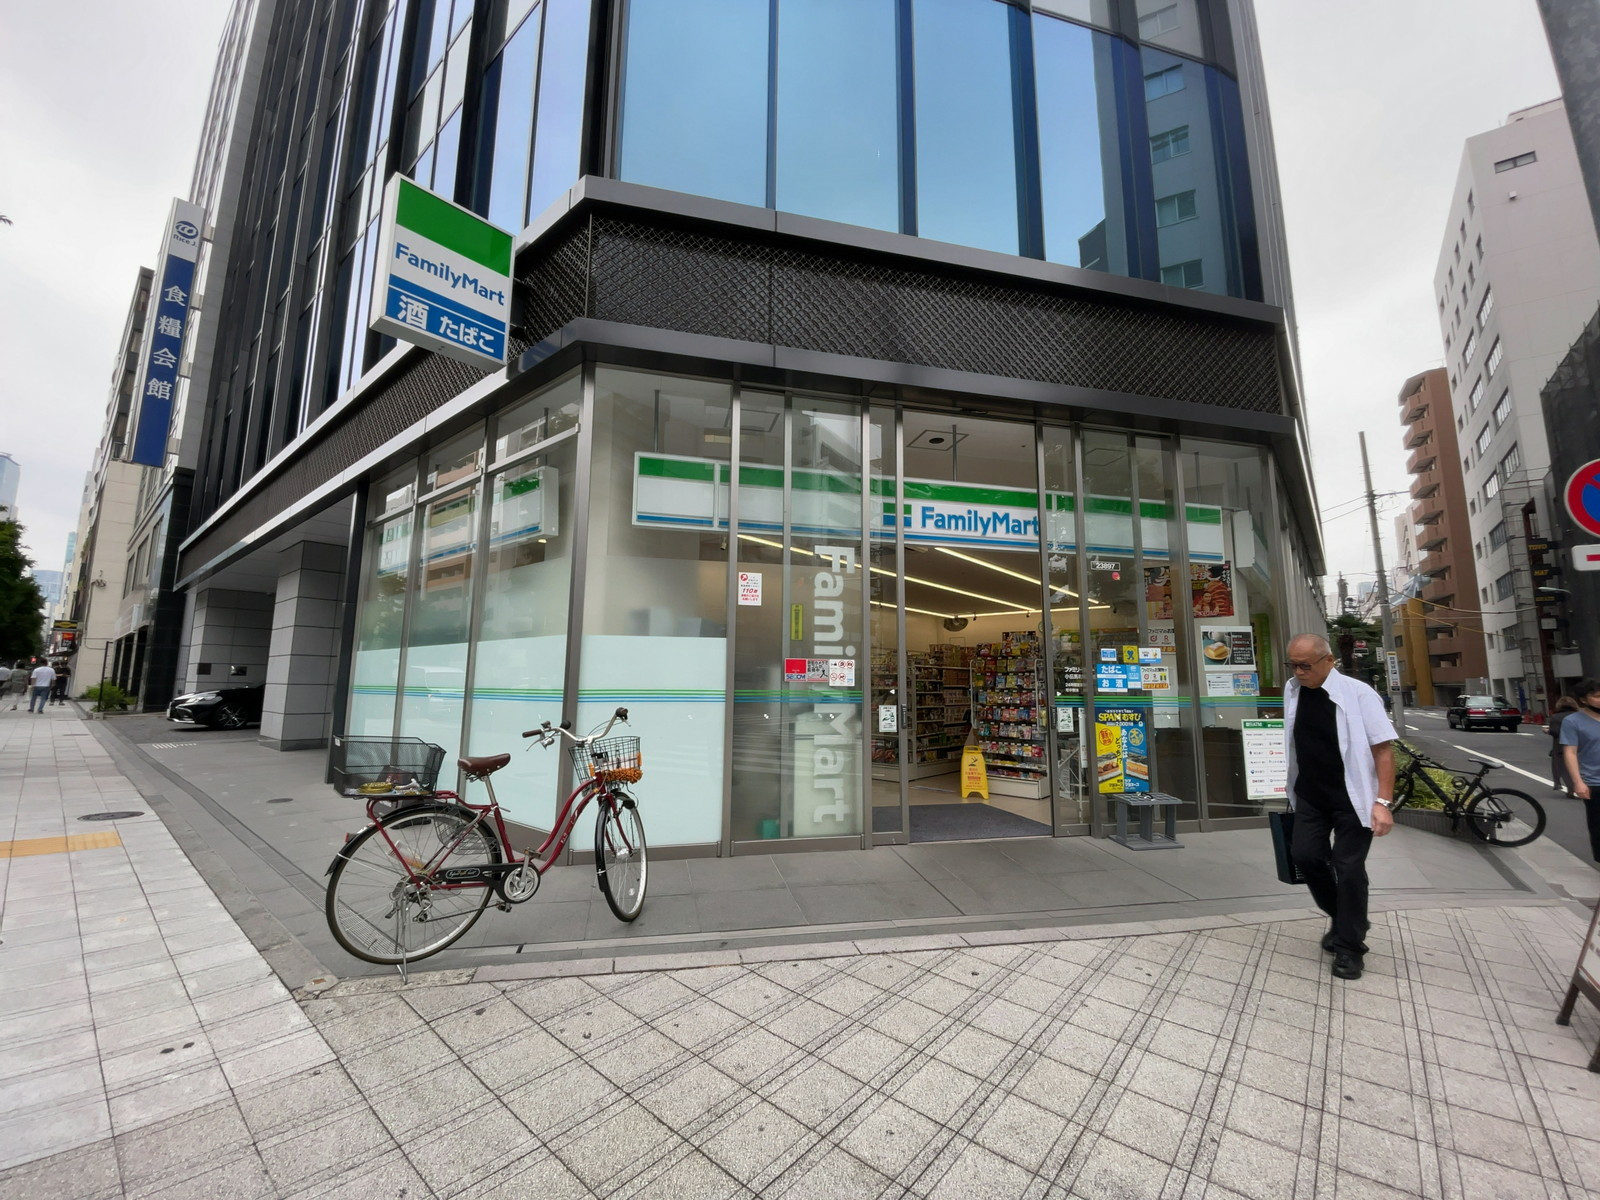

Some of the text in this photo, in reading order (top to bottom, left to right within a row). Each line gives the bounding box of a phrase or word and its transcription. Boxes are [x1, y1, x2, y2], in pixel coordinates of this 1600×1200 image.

[394, 241, 505, 306] FamilyMart
[146, 285, 189, 401] 食糧会館
[397, 295, 495, 353] 酒 たばこ
[920, 505, 1041, 536] FamilyMart
[1094, 561, 1116, 571] 23897
[1101, 665, 1122, 674] たばこ
